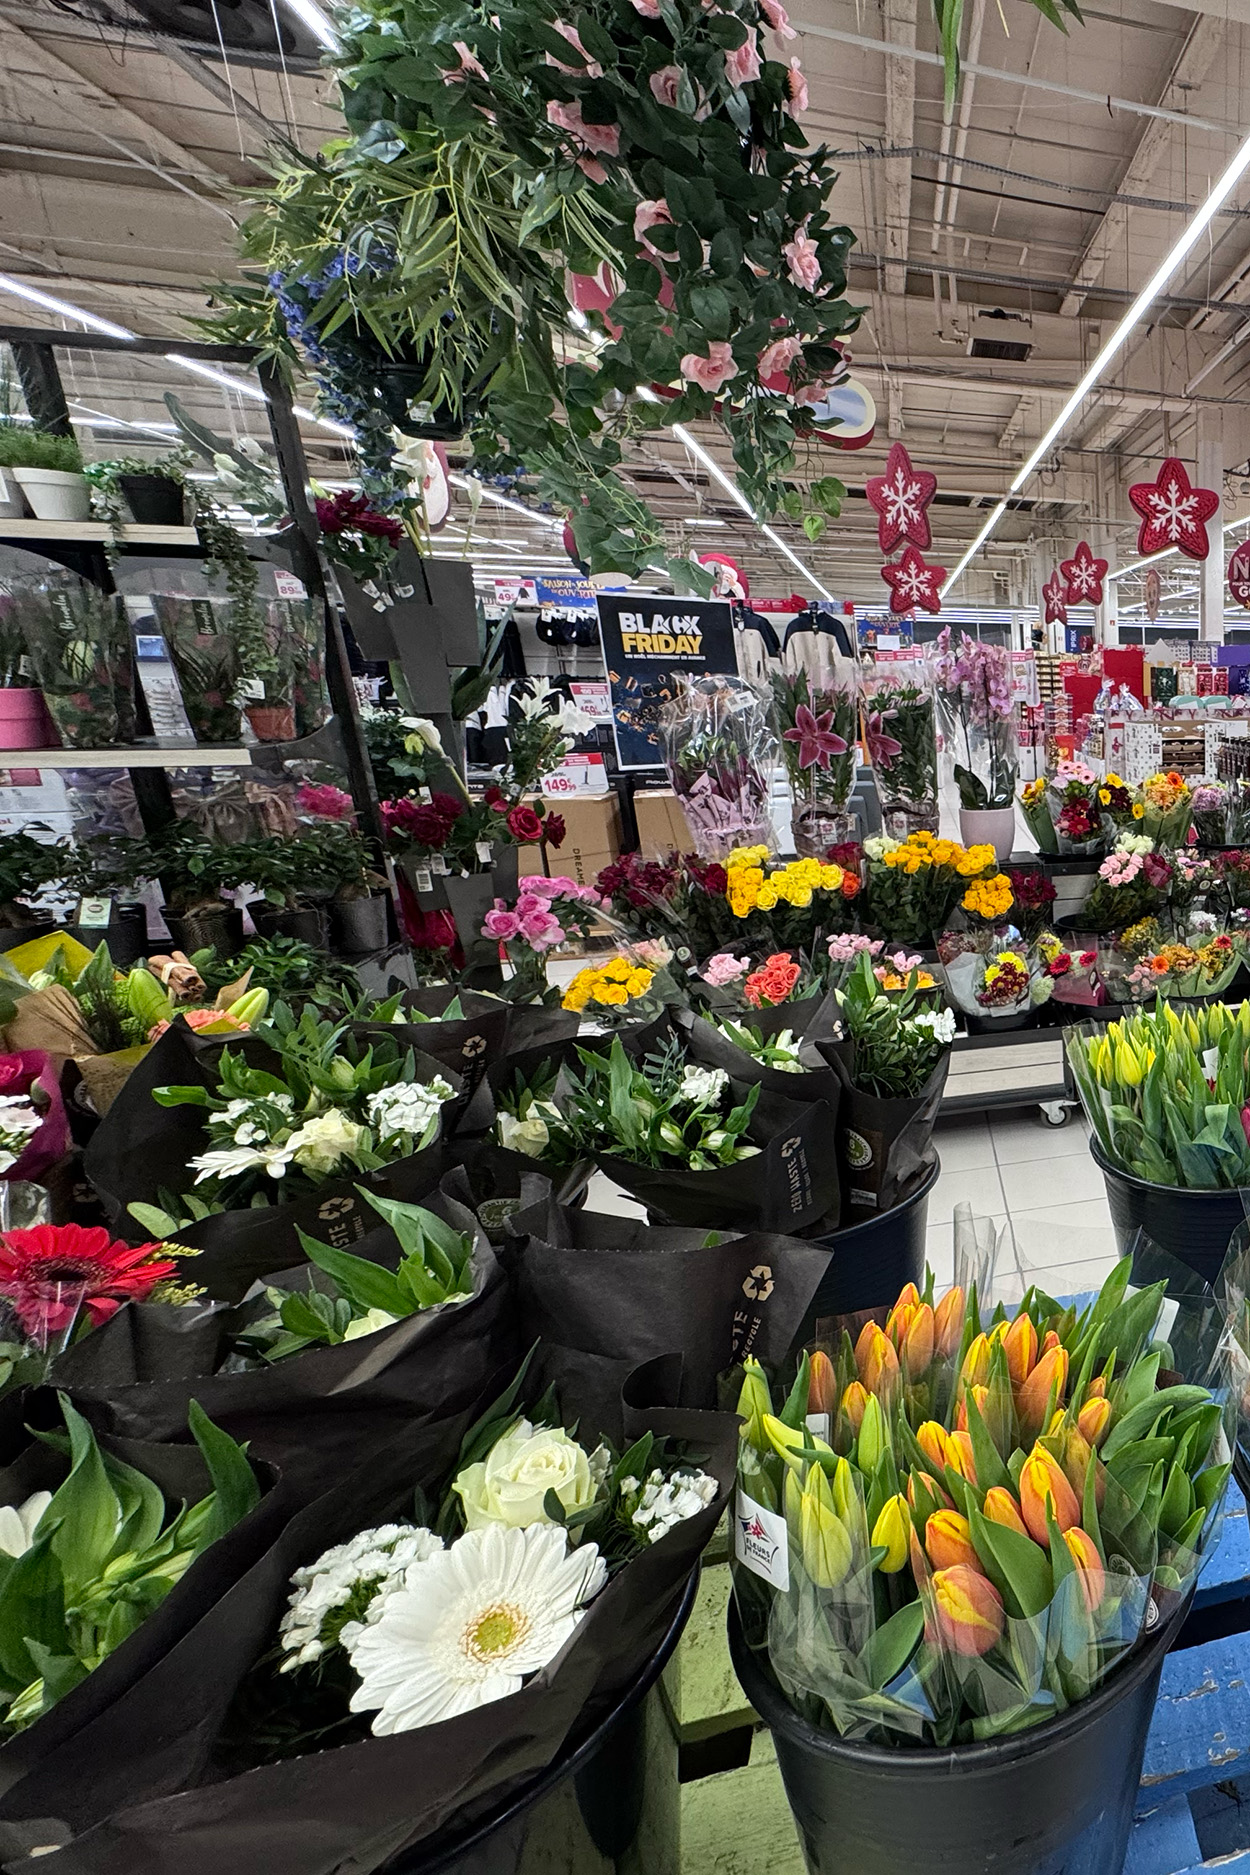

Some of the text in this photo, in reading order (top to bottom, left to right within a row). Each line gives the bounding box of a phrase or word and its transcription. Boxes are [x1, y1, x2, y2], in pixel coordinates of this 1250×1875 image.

[618, 612, 703, 635] BLACK
[621, 632, 703, 655] FRIDAY
[573, 848, 585, 885] DREAME
[787, 1157, 801, 1191] WASTE
[741, 1316, 761, 1358] RECYCLE
[746, 1538, 770, 1558] FLEURS
